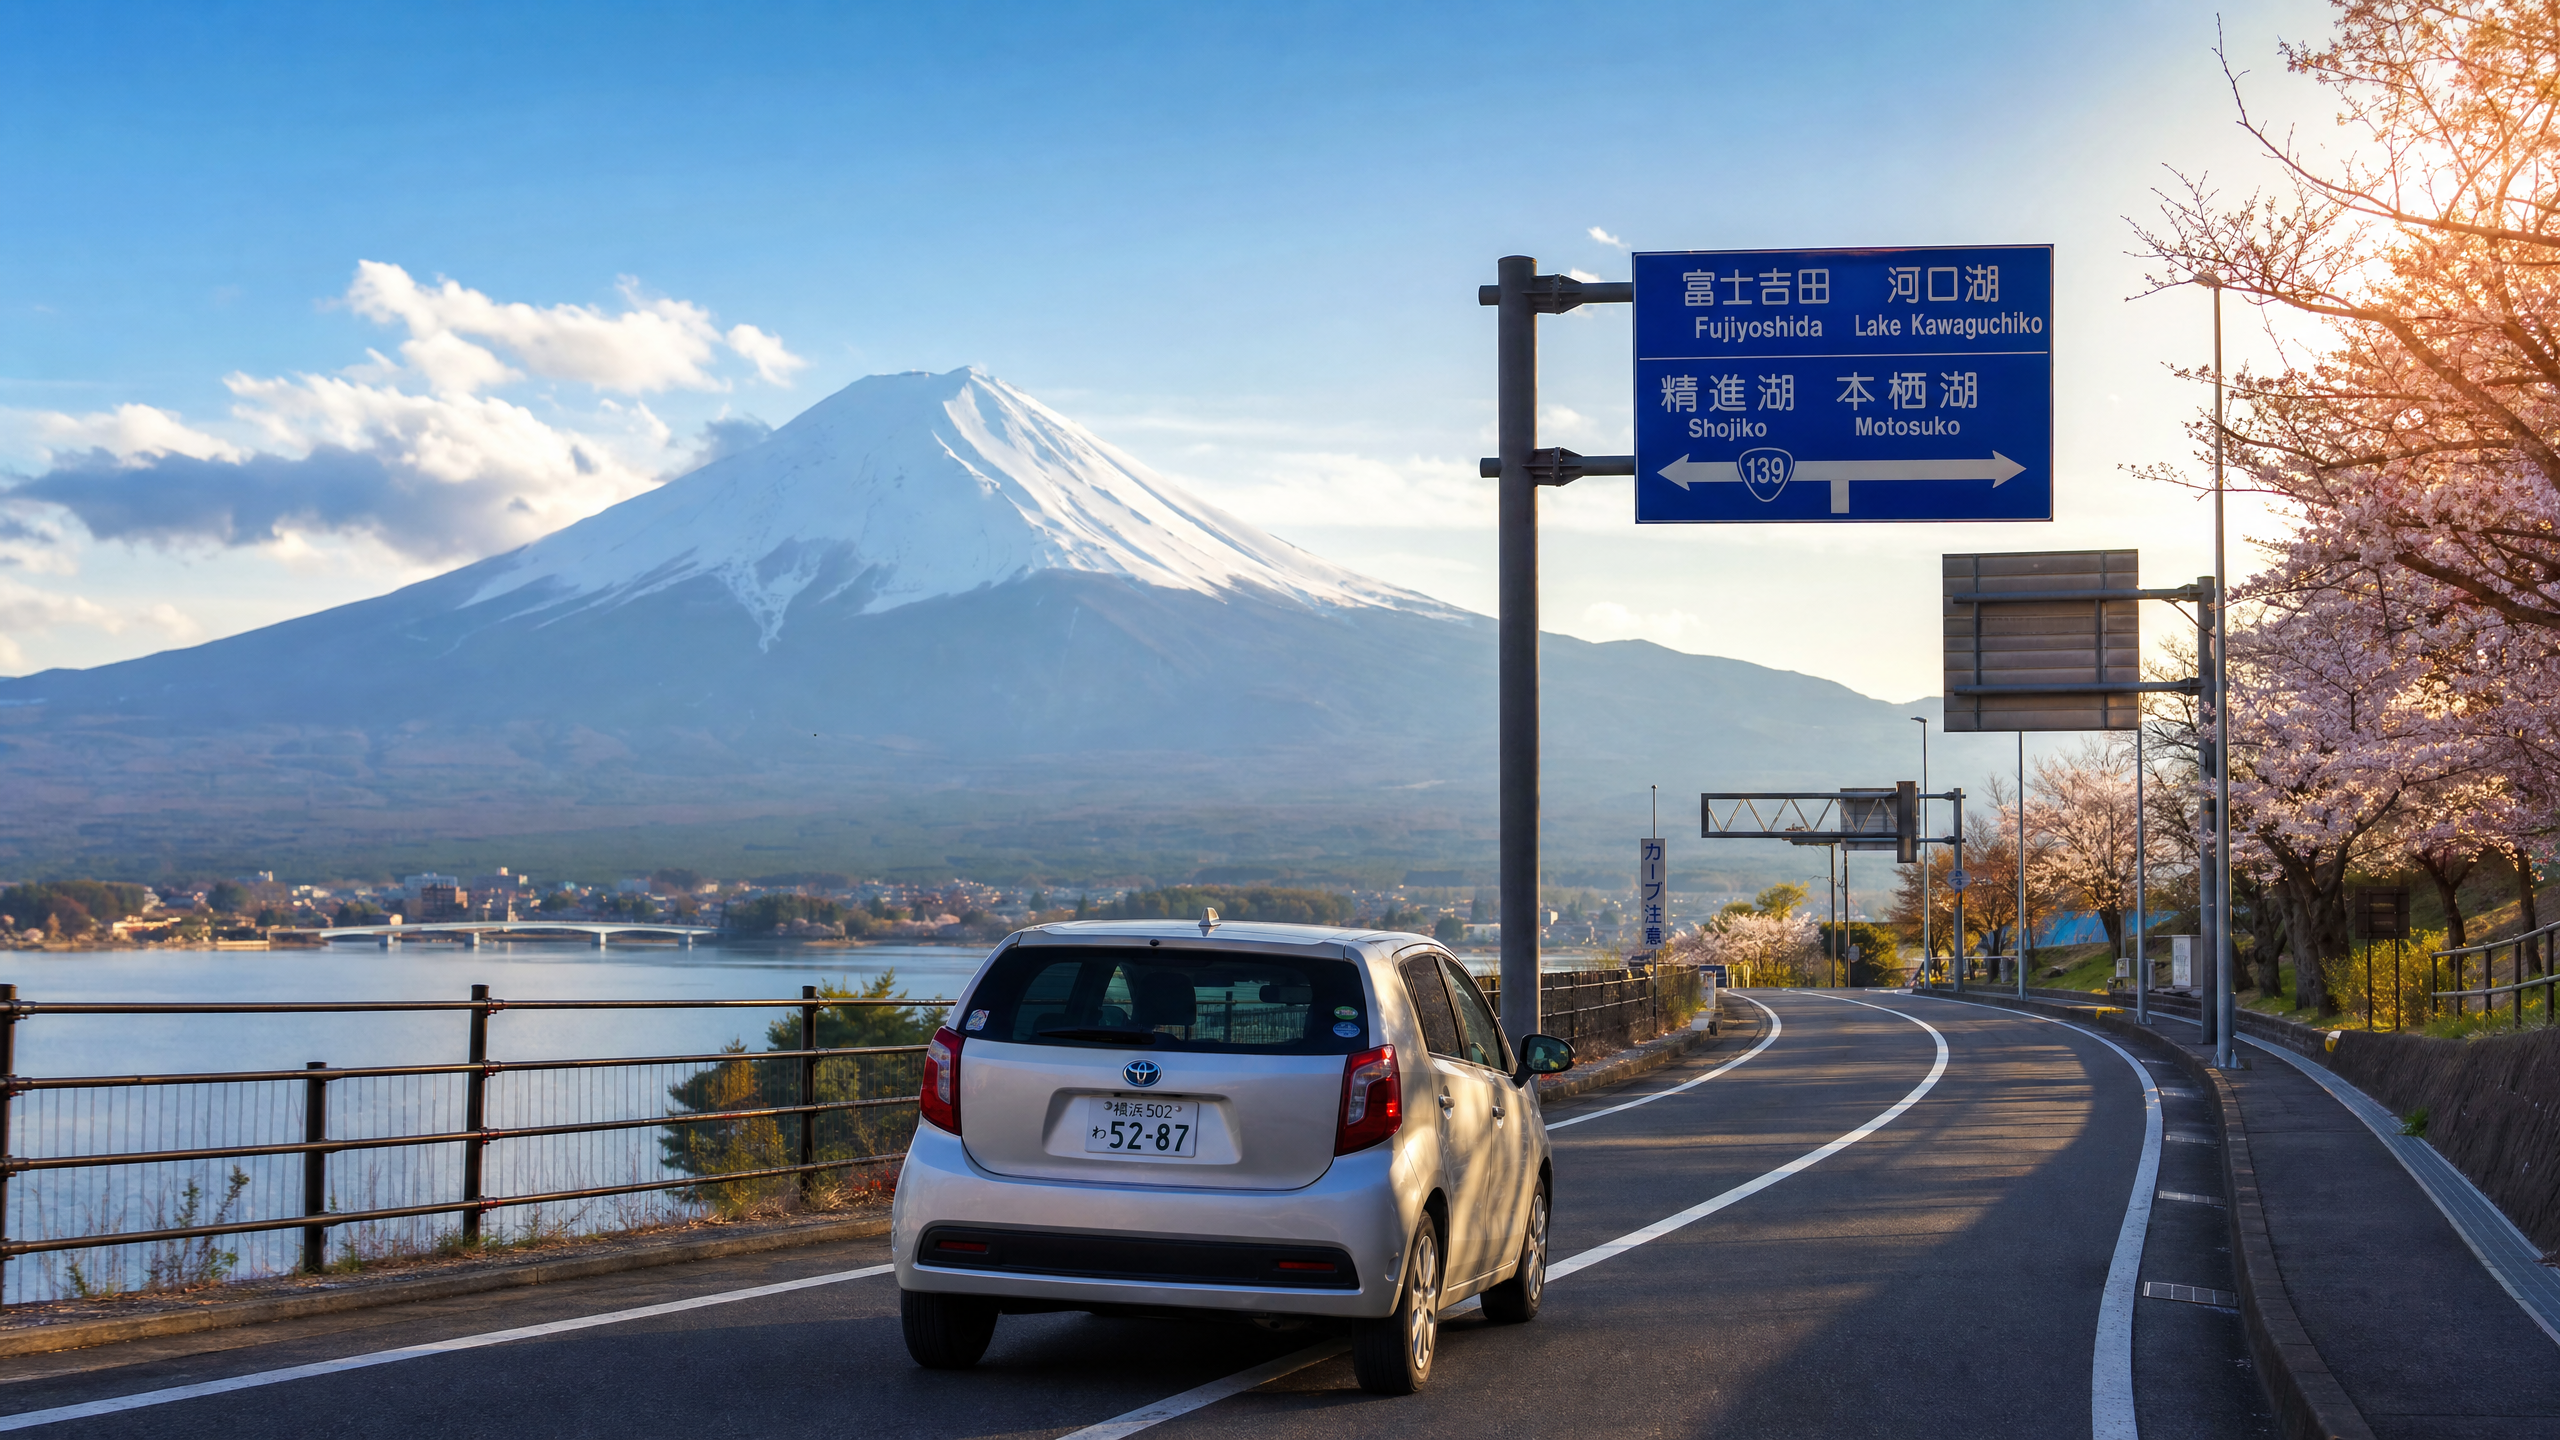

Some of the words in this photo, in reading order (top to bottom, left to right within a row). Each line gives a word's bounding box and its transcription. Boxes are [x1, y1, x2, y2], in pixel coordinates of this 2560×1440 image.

[1682, 267, 1831, 307] 富士吉田
[1887, 264, 2000, 304] 河口湖
[1695, 315, 1824, 343] Fujiyoshida
[1855, 314, 1902, 337] Lake
[1911, 312, 2043, 340] Kawaguchiko
[1660, 374, 1795, 413] 精進湖
[1836, 371, 1978, 411] 本栖湖
[1688, 418, 1768, 441] Shojiko
[1855, 416, 1961, 437] Motosuko
[1746, 457, 1785, 485] 139
[1645, 843, 1663, 945] カーブ注意
[1146, 1103, 1173, 1119] 502
[1092, 1125, 1107, 1140] わ
[1109, 1120, 1190, 1152] 52-87
